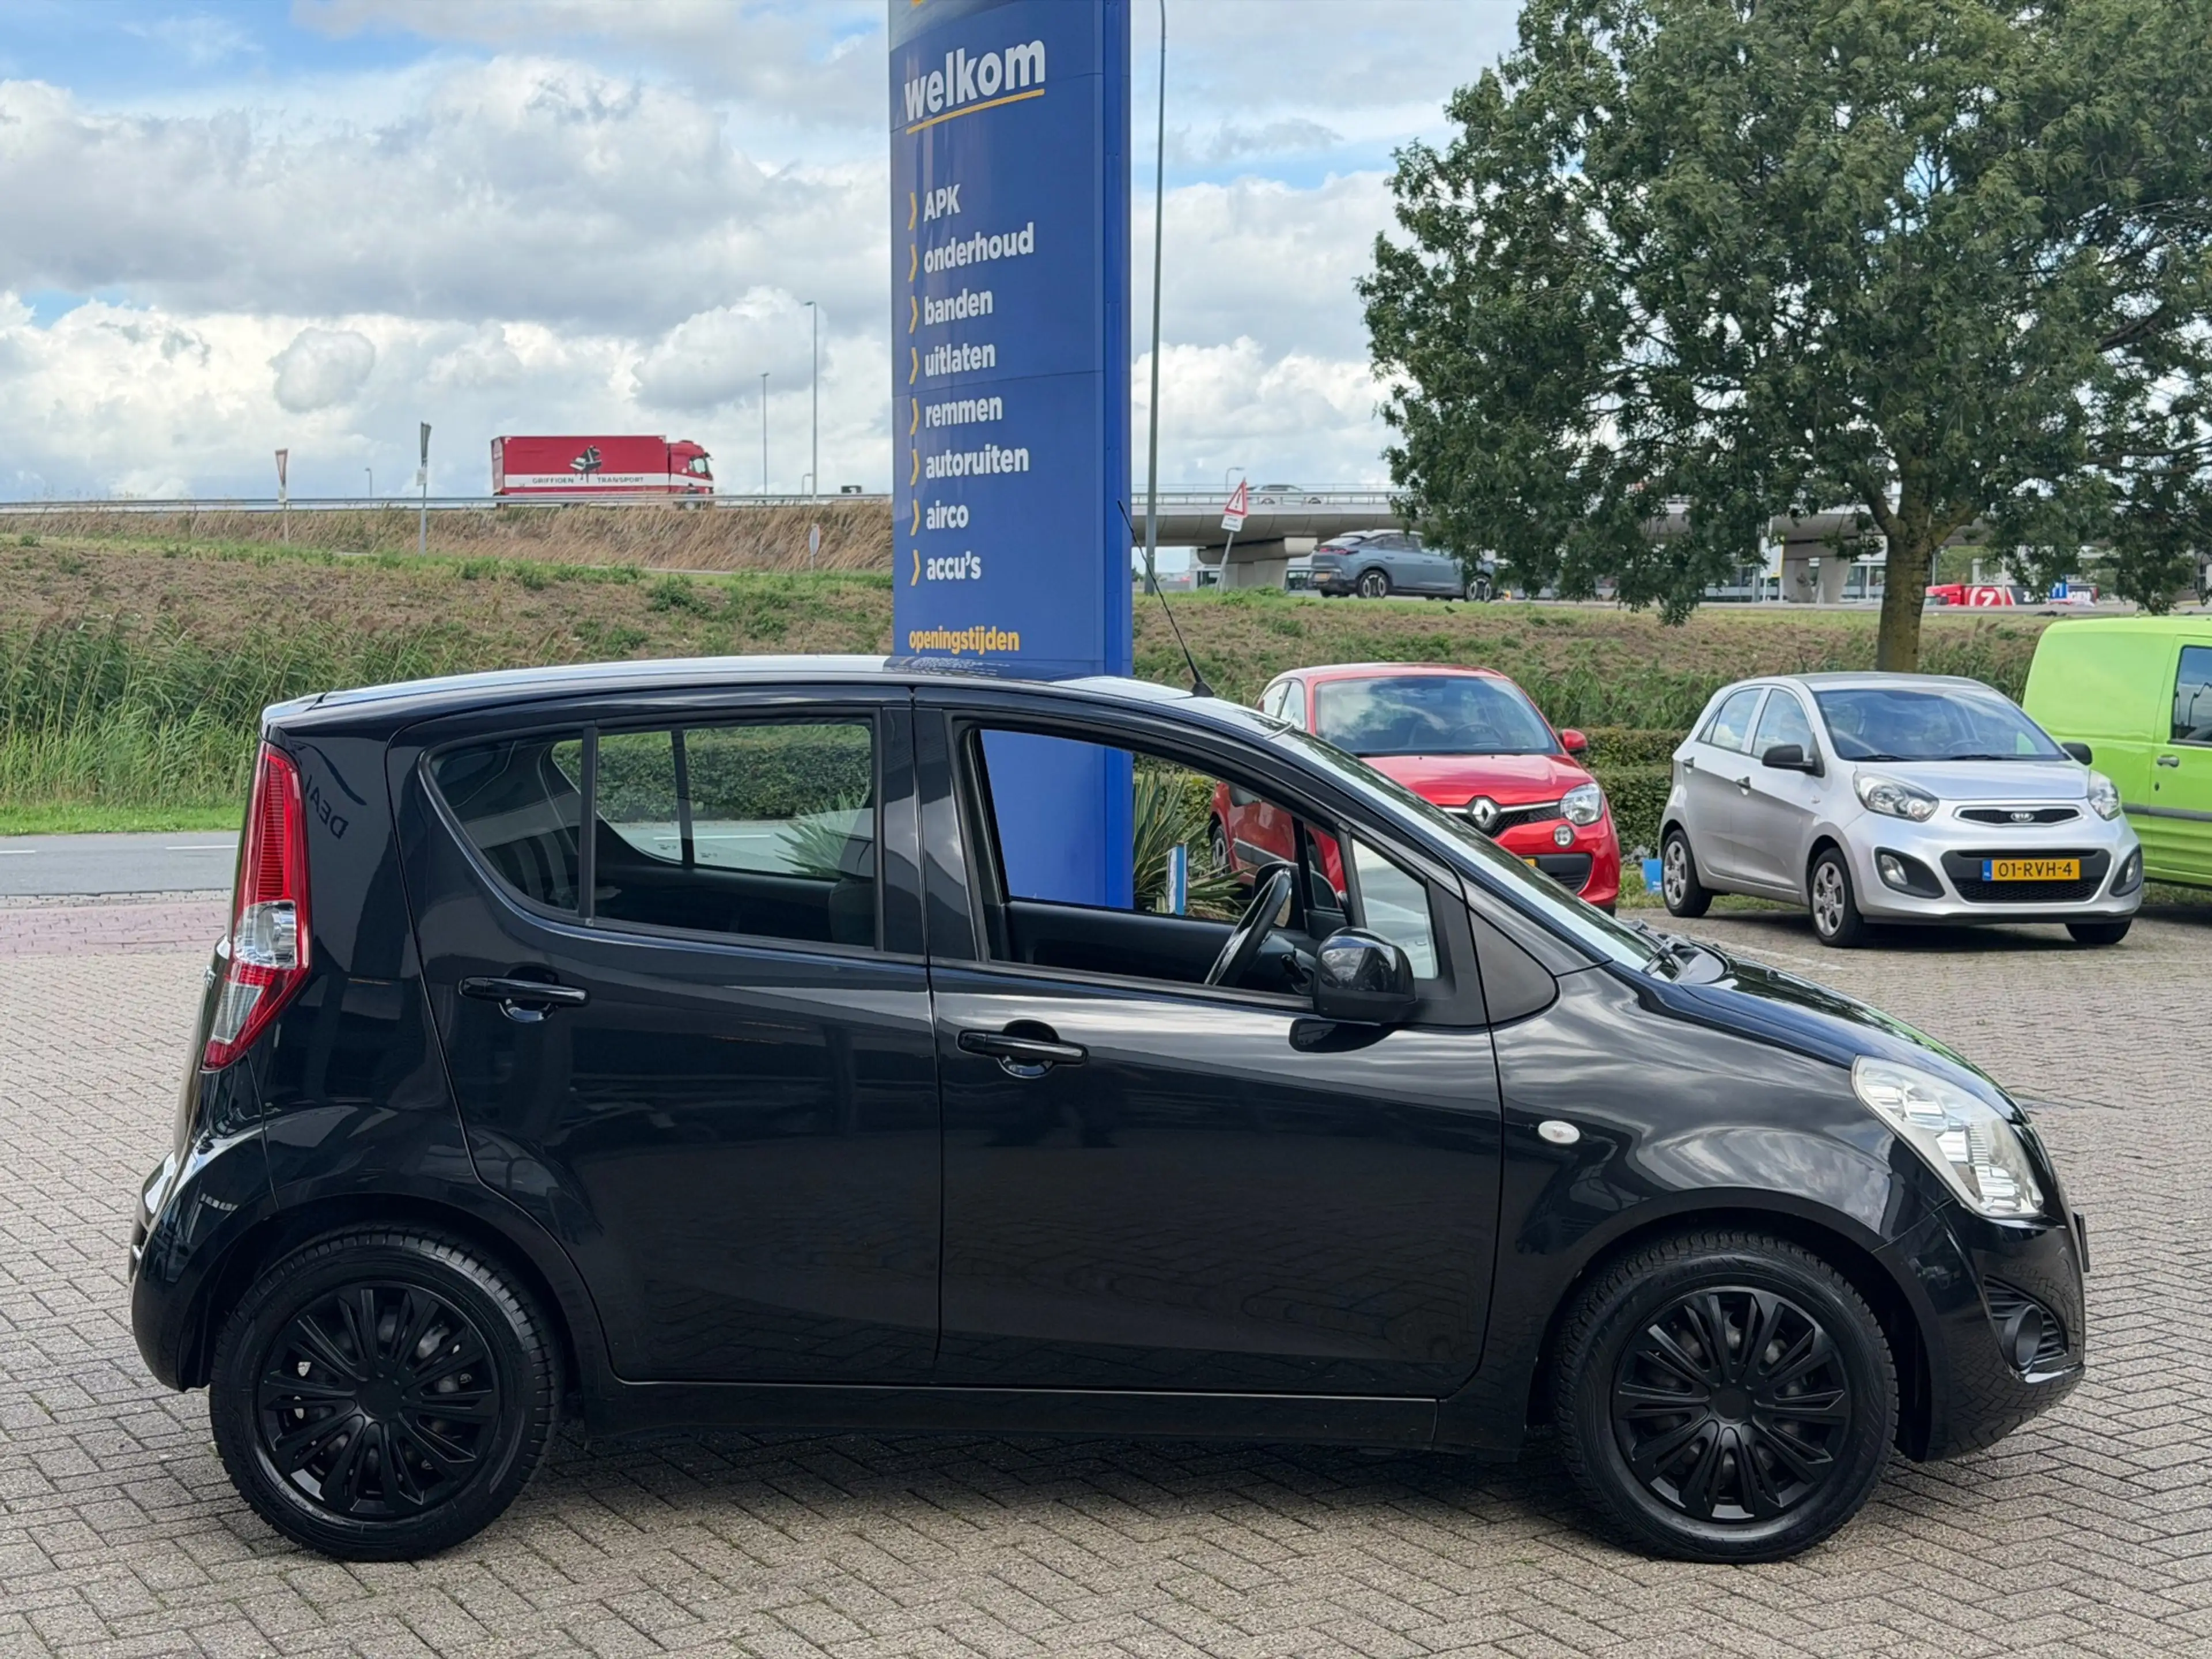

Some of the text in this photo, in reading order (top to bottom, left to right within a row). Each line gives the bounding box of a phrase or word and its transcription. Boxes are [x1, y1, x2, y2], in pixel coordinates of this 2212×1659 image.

[904, 40, 1046, 122] welkom
[923, 184, 961, 222] APK
[924, 221, 1034, 274] onderhoud
[925, 288, 993, 325] banden
[925, 343, 996, 377] uitlaten
[925, 396, 1003, 428] remmen
[926, 444, 1029, 479] autoruiten
[926, 500, 969, 530] airco
[926, 551, 982, 580] accu's
[909, 626, 1020, 654] openingstijden
[1998, 862, 2073, 877] 01-RVH-4
